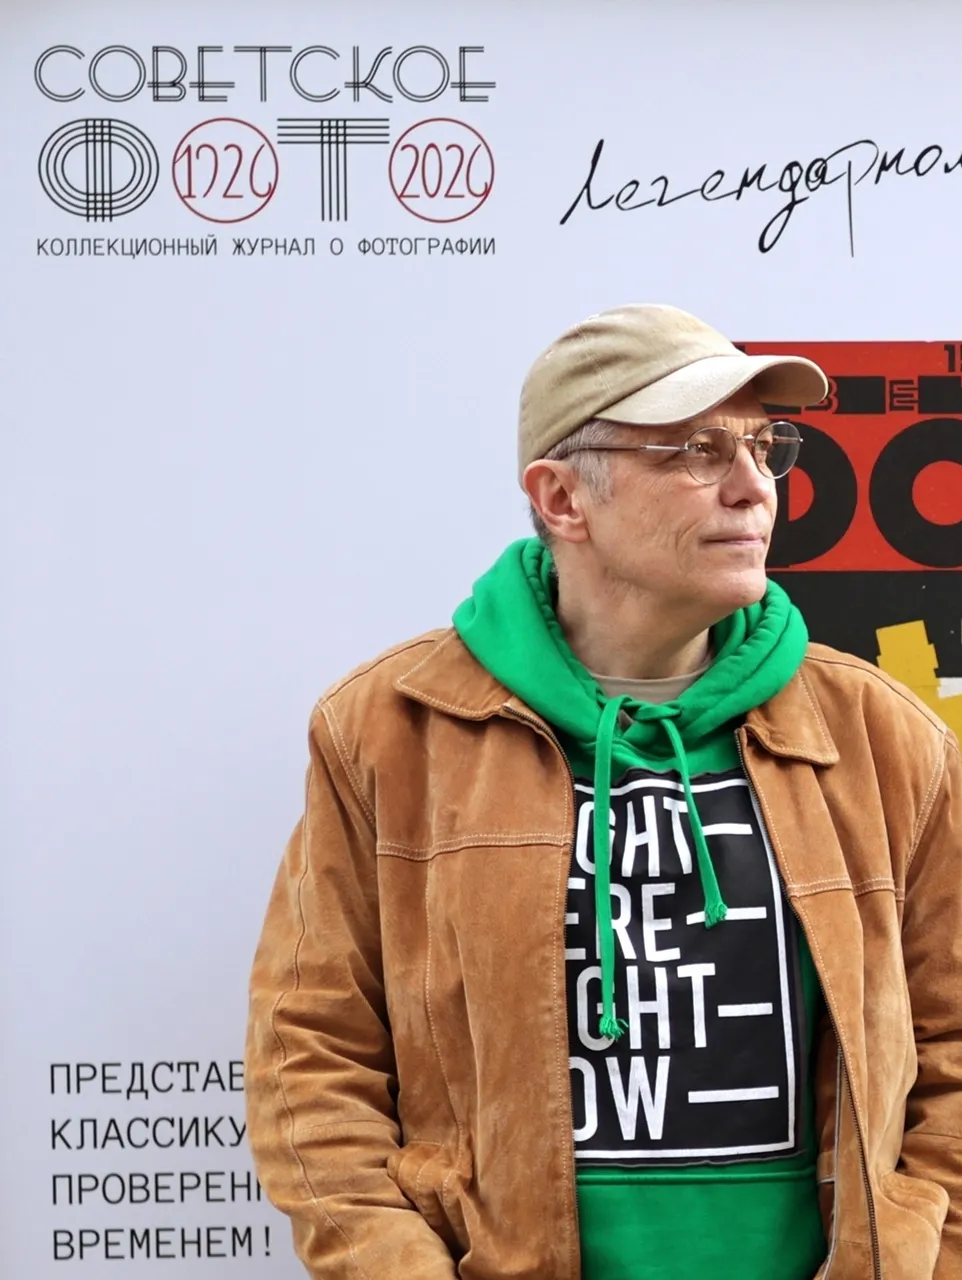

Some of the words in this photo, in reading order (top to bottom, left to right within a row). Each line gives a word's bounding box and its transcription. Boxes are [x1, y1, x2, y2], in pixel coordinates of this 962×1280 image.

[34, 45, 496, 103] СОВЕТСКОЕ
[173, 143, 274, 200] 1926
[399, 143, 490, 200] 2026
[36, 236, 218, 259] КОЛЛЕКЦИОННЫЙ
[232, 239, 316, 257] ЖУРНАЛ
[329, 239, 344, 256] О
[358, 237, 496, 257] ФОТОГРАФИИ
[53, 1226, 272, 1261] ВРЕМЕНЕМ!
